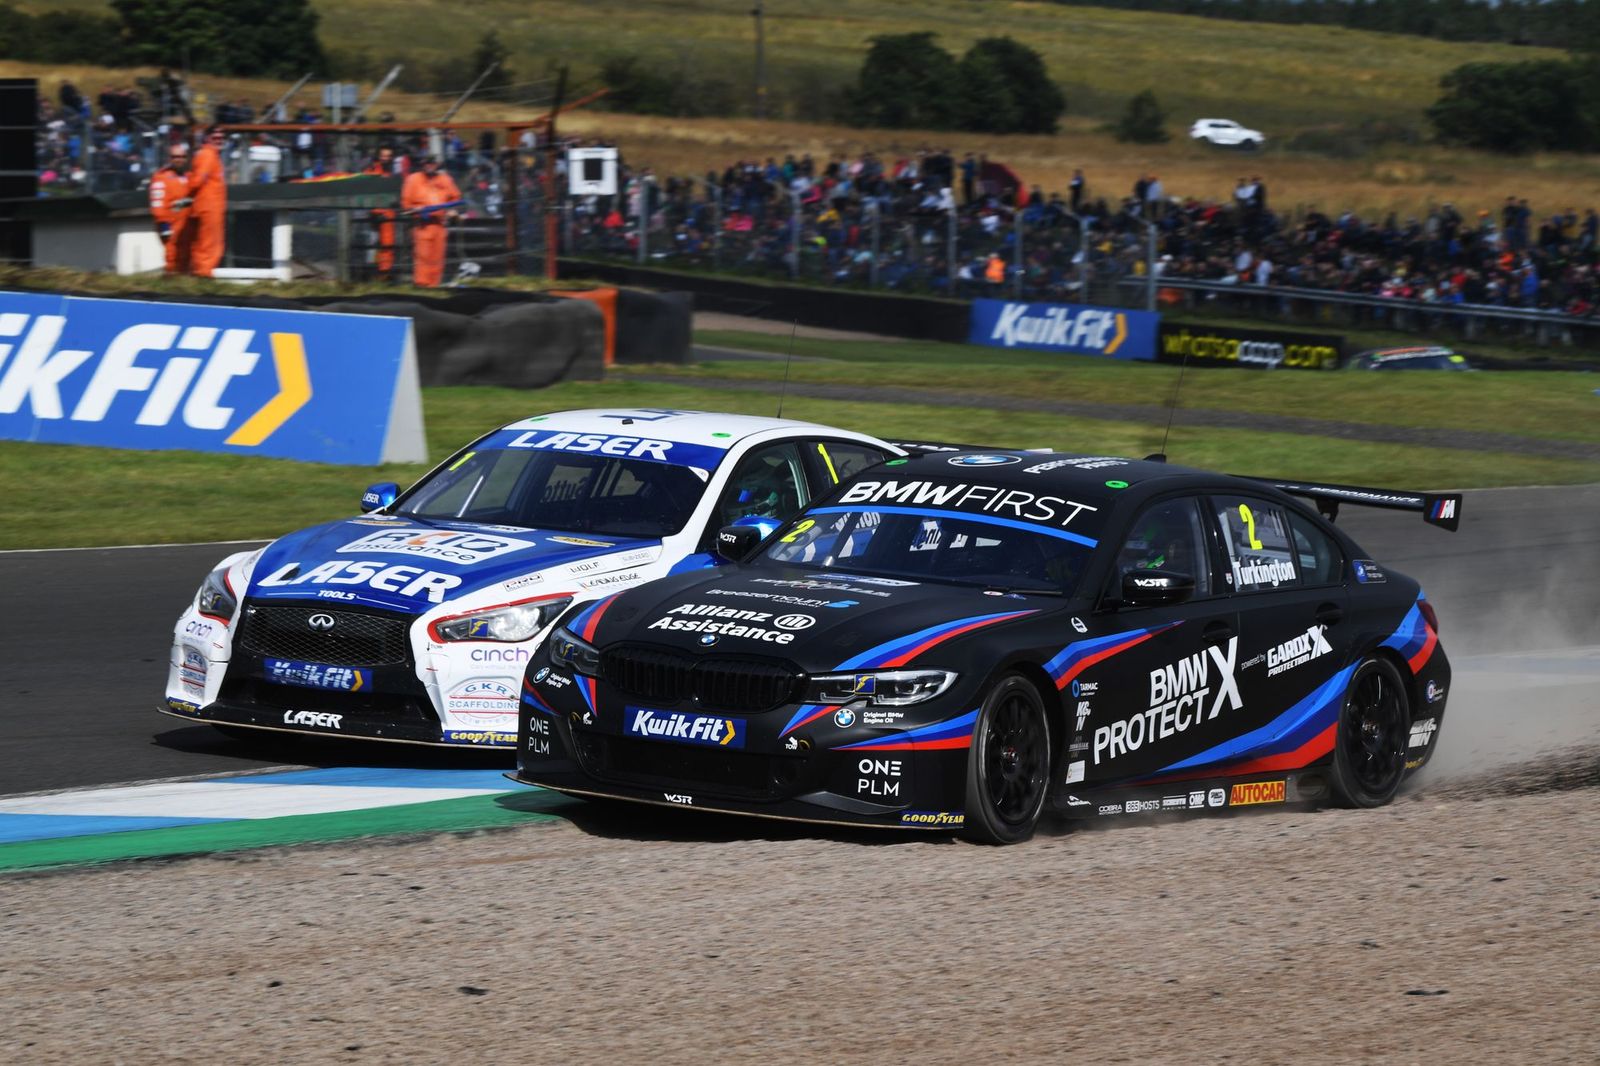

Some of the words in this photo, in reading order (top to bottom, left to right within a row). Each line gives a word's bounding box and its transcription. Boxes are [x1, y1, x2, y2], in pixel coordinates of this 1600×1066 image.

[507, 431, 673, 461] LASER
[449, 452, 476, 471] 1
[817, 443, 839, 485] 1
[362, 492, 380, 504] LASER
[780, 519, 816, 543] 2
[1238, 503, 1263, 550] 2
[256, 560, 463, 603] LASER
[1233, 558, 1296, 587] Turkington
[1134, 578, 1169, 587] WSR
[317, 589, 357, 601] TOOLS
[667, 603, 773, 622] Allianz
[647, 616, 795, 645] Assistance
[470, 647, 530, 662] cinch
[1150, 649, 1208, 707] BMW
[465, 682, 507, 695] GKR
[283, 709, 343, 729] LASER
[863, 712, 887, 720] Original
[530, 717, 549, 735] ONE
[1093, 687, 1210, 765] PROTECT
[528, 736, 550, 755] PLM
[858, 758, 902, 776] ONE
[857, 778, 900, 797] PLM
[1230, 782, 1285, 804] AUTOCAR
[664, 793, 693, 804] WSR
[902, 812, 965, 824] GOODYEAR
